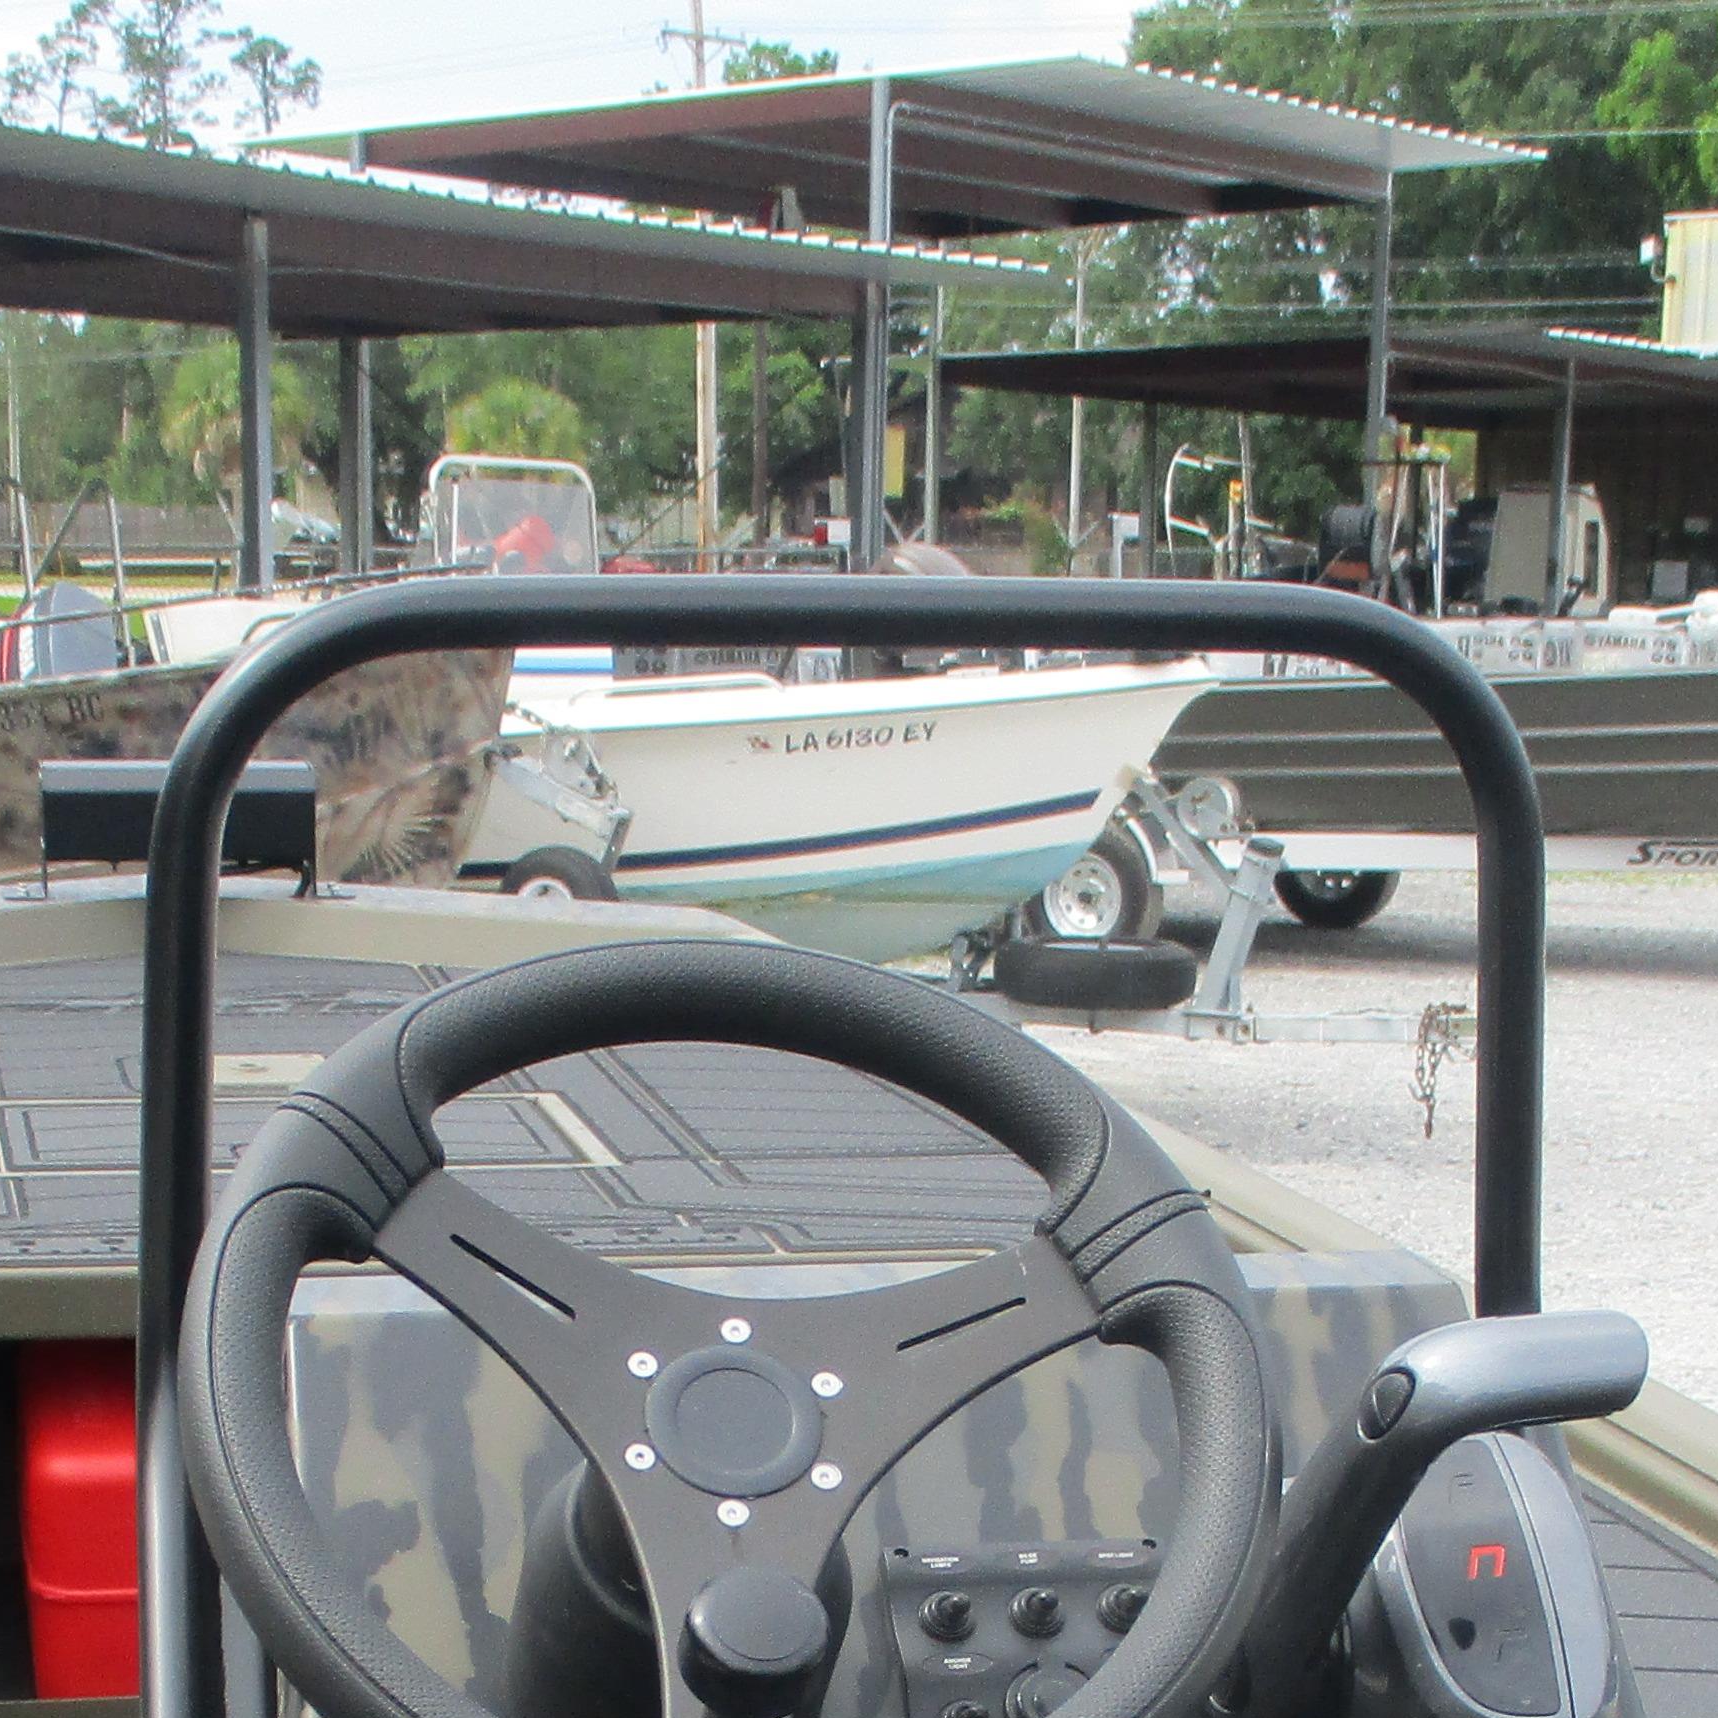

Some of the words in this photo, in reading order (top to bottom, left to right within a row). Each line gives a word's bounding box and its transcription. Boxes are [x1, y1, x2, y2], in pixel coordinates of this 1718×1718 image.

[784, 731, 820, 754] LA
[825, 726, 895, 751] 6130
[901, 720, 939, 744] EY
